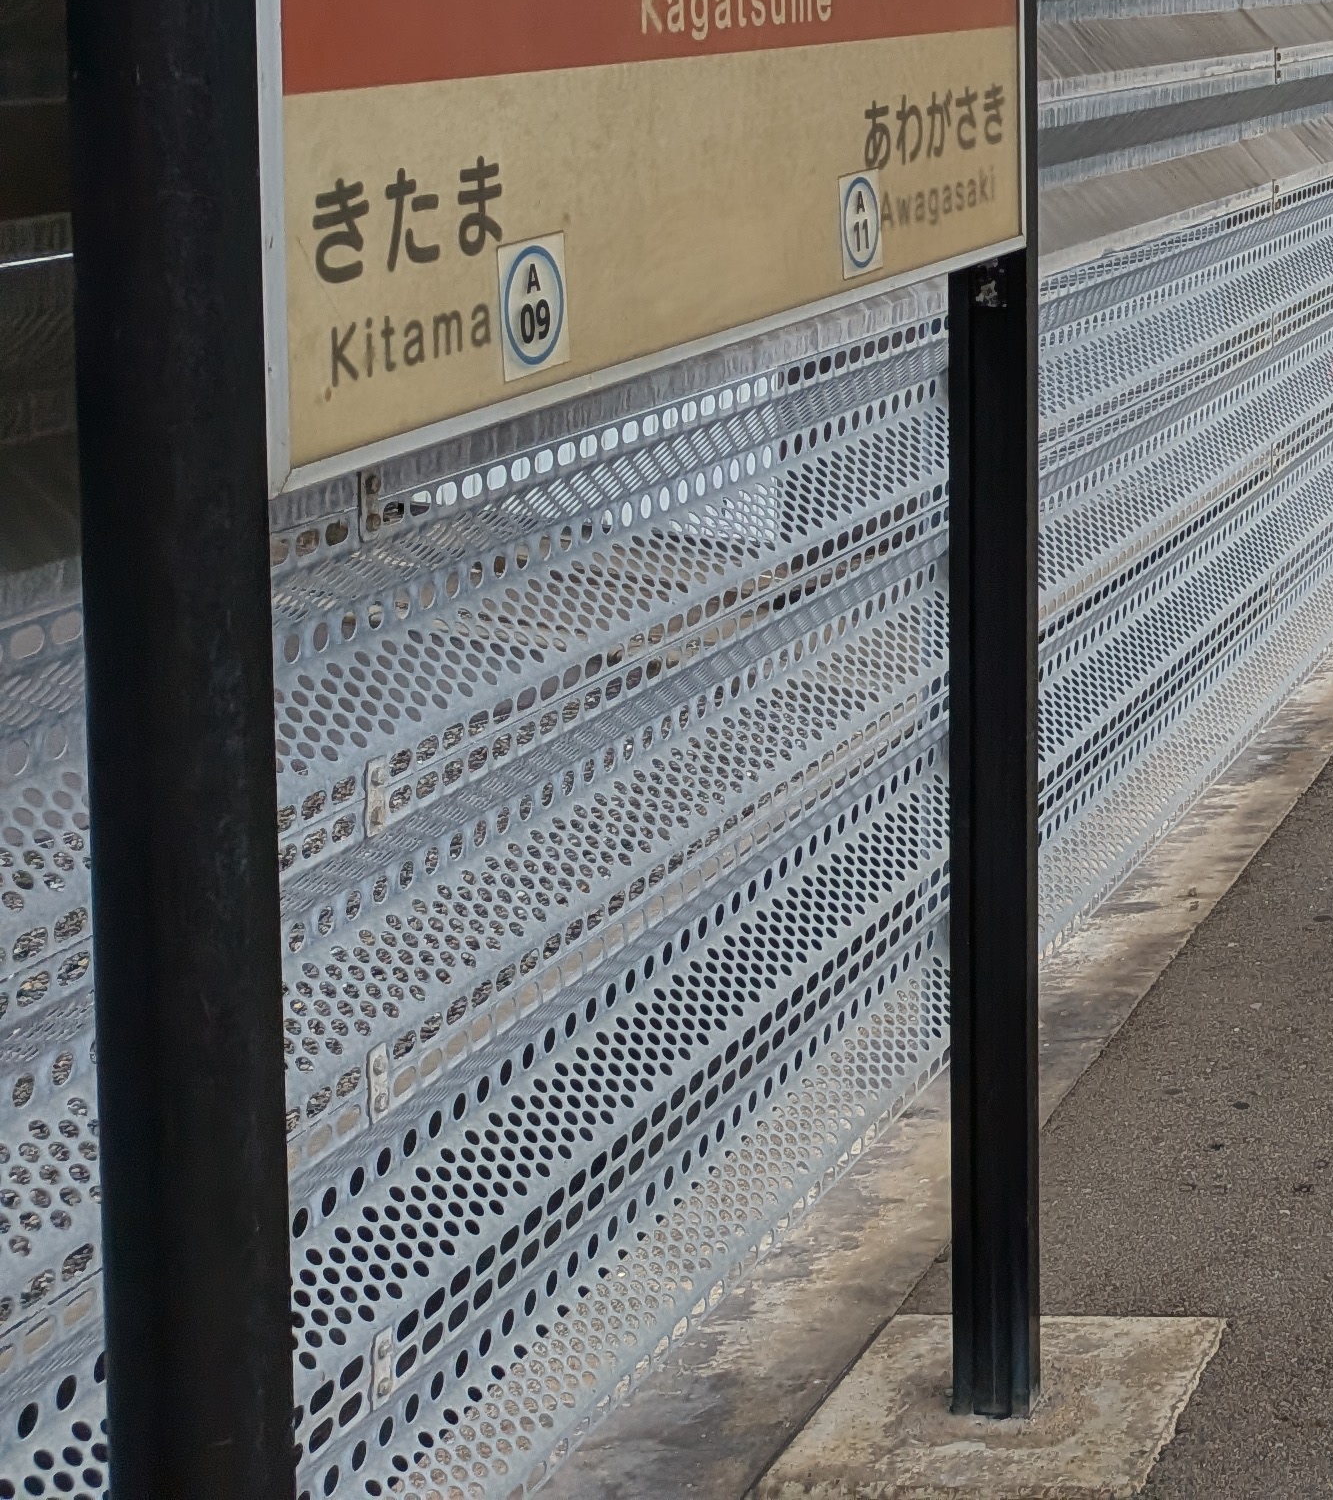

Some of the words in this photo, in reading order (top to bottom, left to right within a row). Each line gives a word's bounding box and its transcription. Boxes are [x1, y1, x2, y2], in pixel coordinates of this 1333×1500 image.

[864, 82, 1005, 171] あわがさき
[312, 155, 503, 284] きたま
[856, 190, 866, 215] A
[880, 165, 996, 228] Awagasaki
[853, 218, 870, 252] 11
[526, 263, 542, 295] A
[330, 303, 491, 388] Kitama
[519, 299, 551, 345] 09
